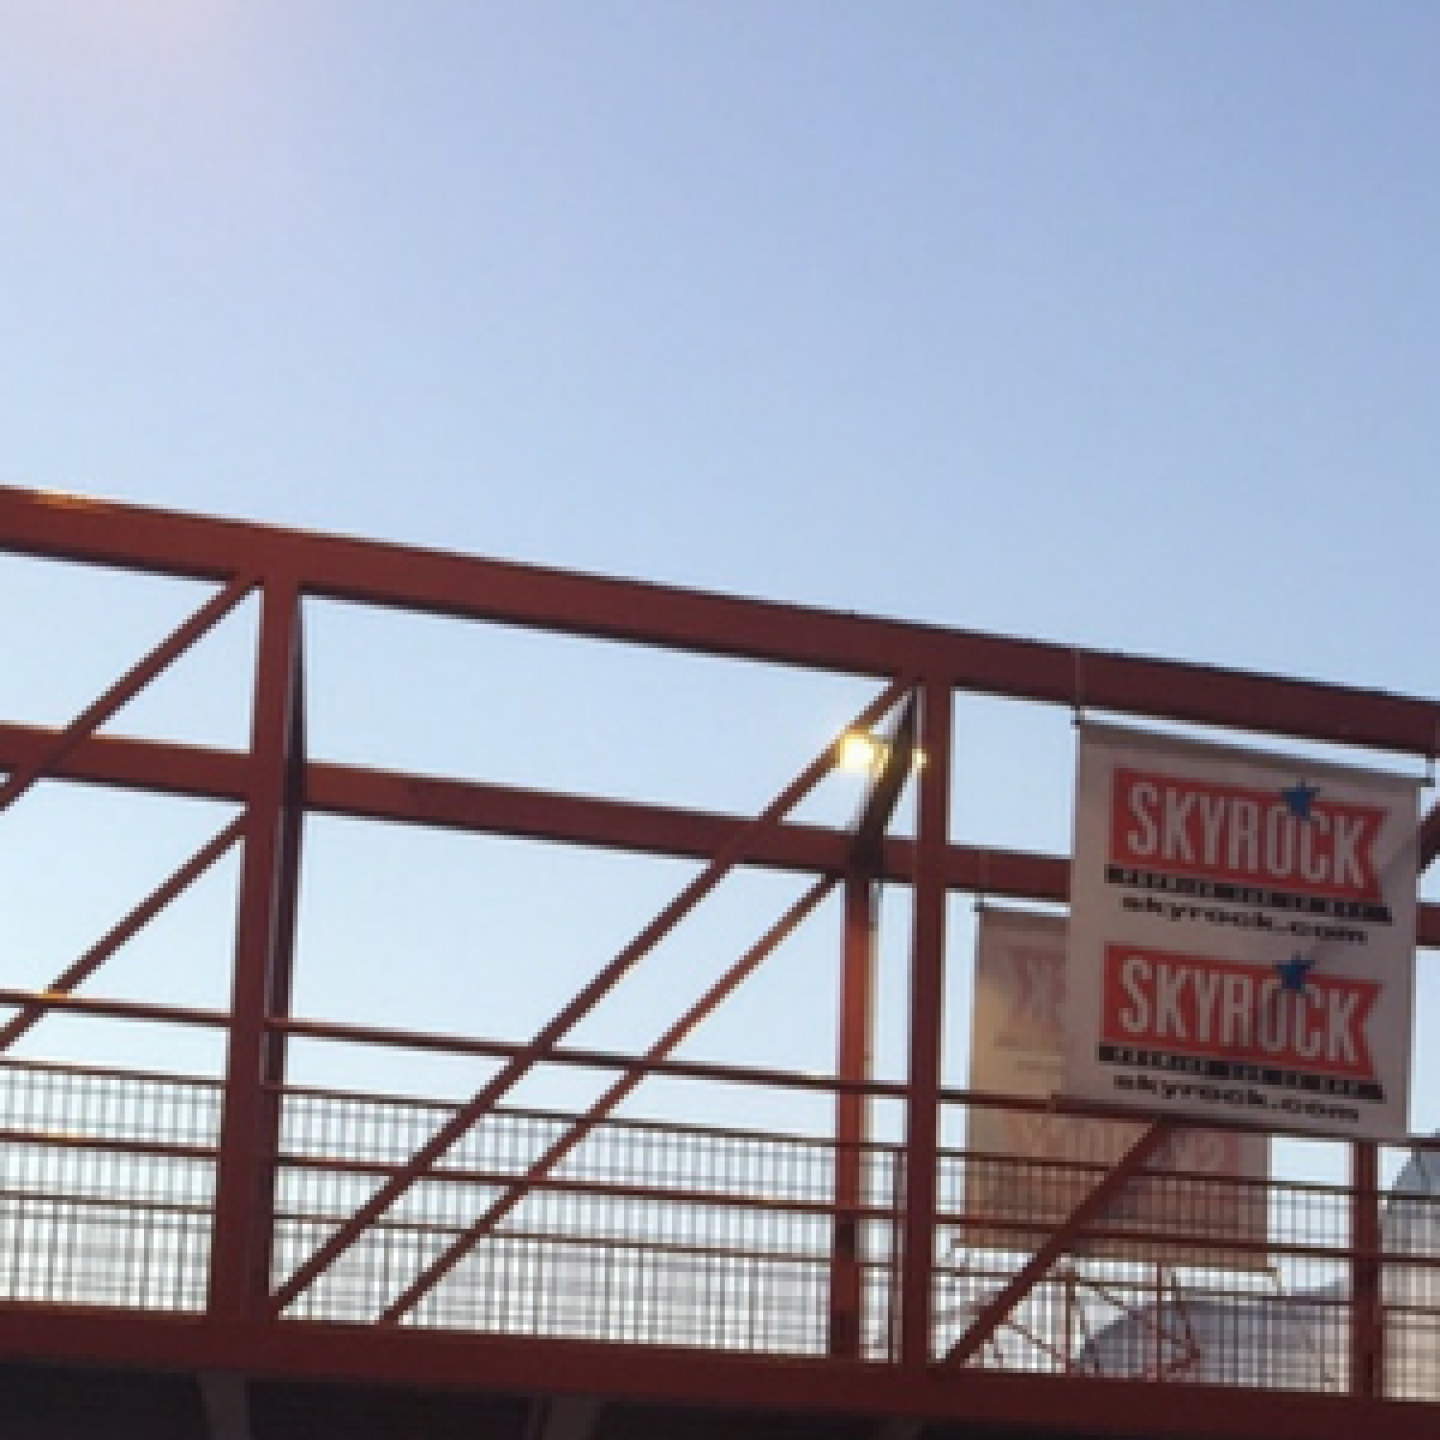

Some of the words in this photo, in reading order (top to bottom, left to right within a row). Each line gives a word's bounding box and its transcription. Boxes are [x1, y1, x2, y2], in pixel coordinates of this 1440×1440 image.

[1127, 782, 1365, 889] SKYROCK
[1121, 897, 1369, 944] skyrock.com
[1118, 958, 1361, 1066] SKYROCK
[1113, 1074, 1360, 1124] skyrock.com
